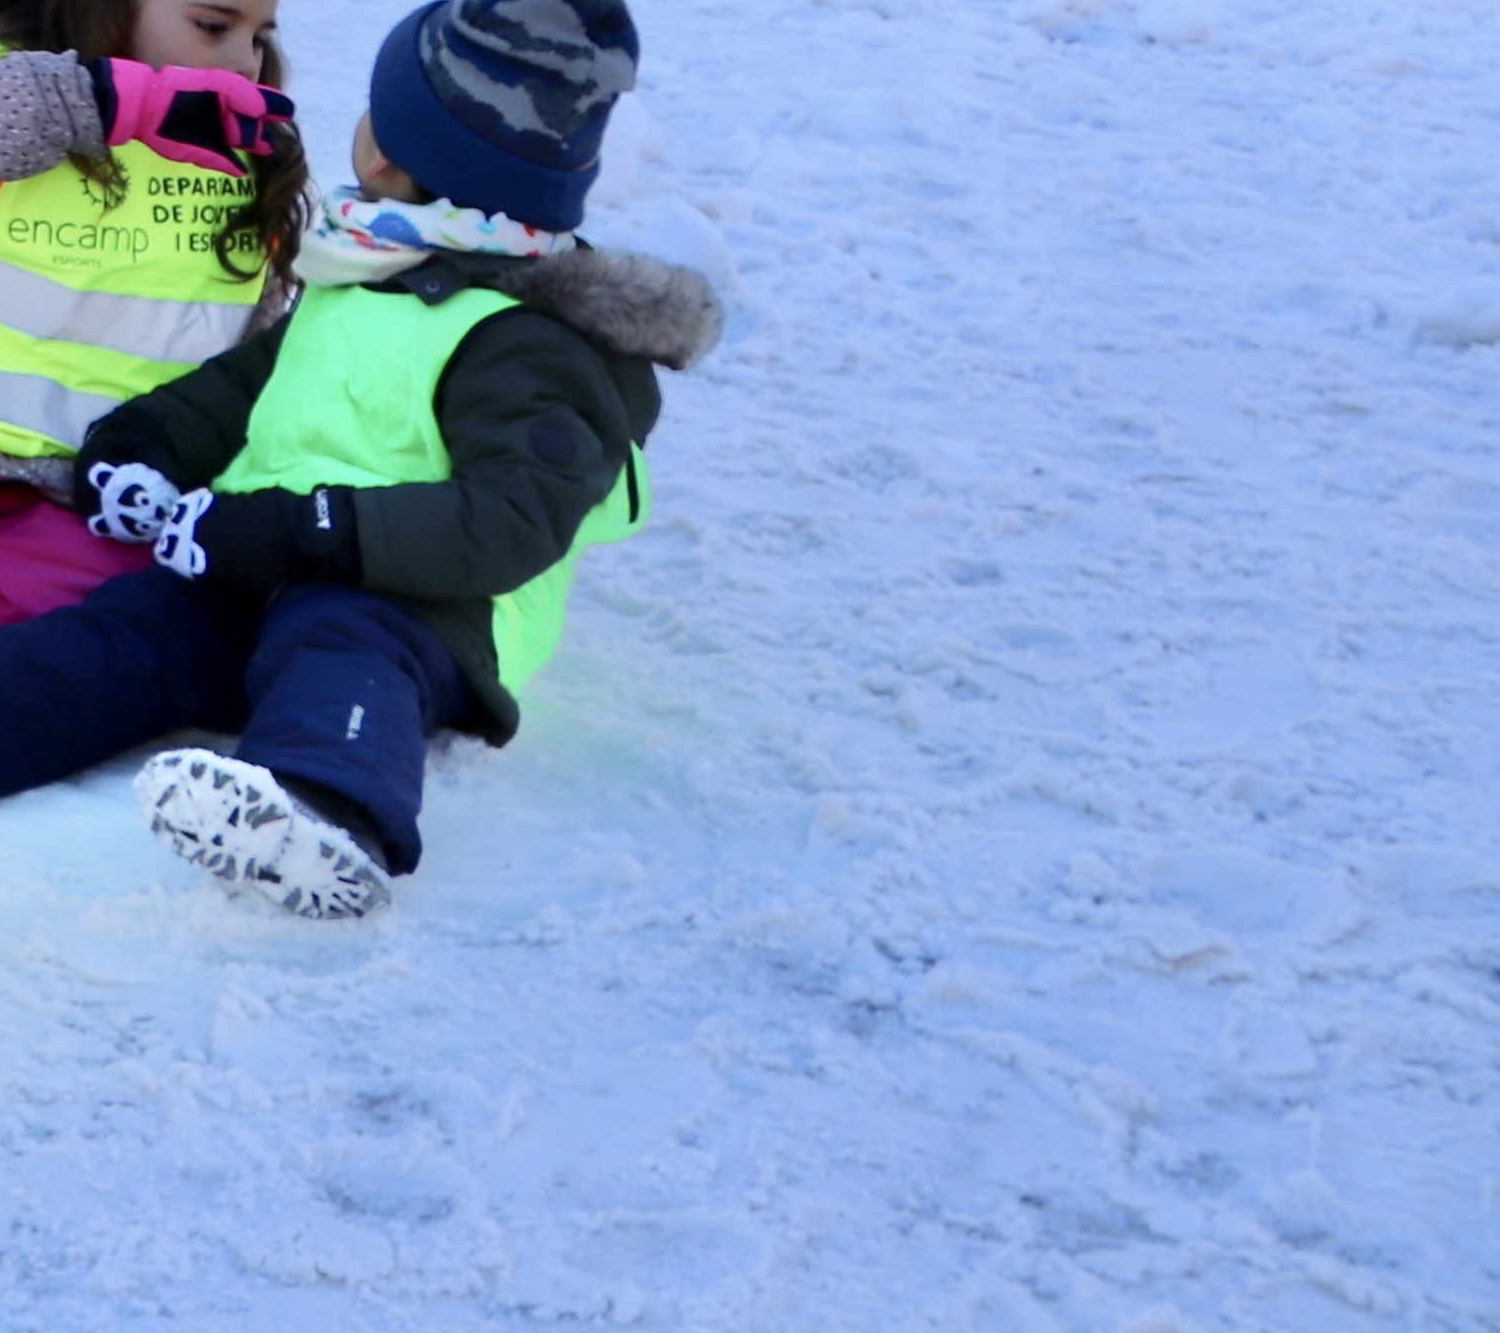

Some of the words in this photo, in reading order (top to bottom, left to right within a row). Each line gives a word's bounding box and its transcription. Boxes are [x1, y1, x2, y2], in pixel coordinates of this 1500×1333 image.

[153, 203, 183, 225] DE
[8, 217, 150, 264] encamp
[53, 255, 102, 270] ESPORTS
